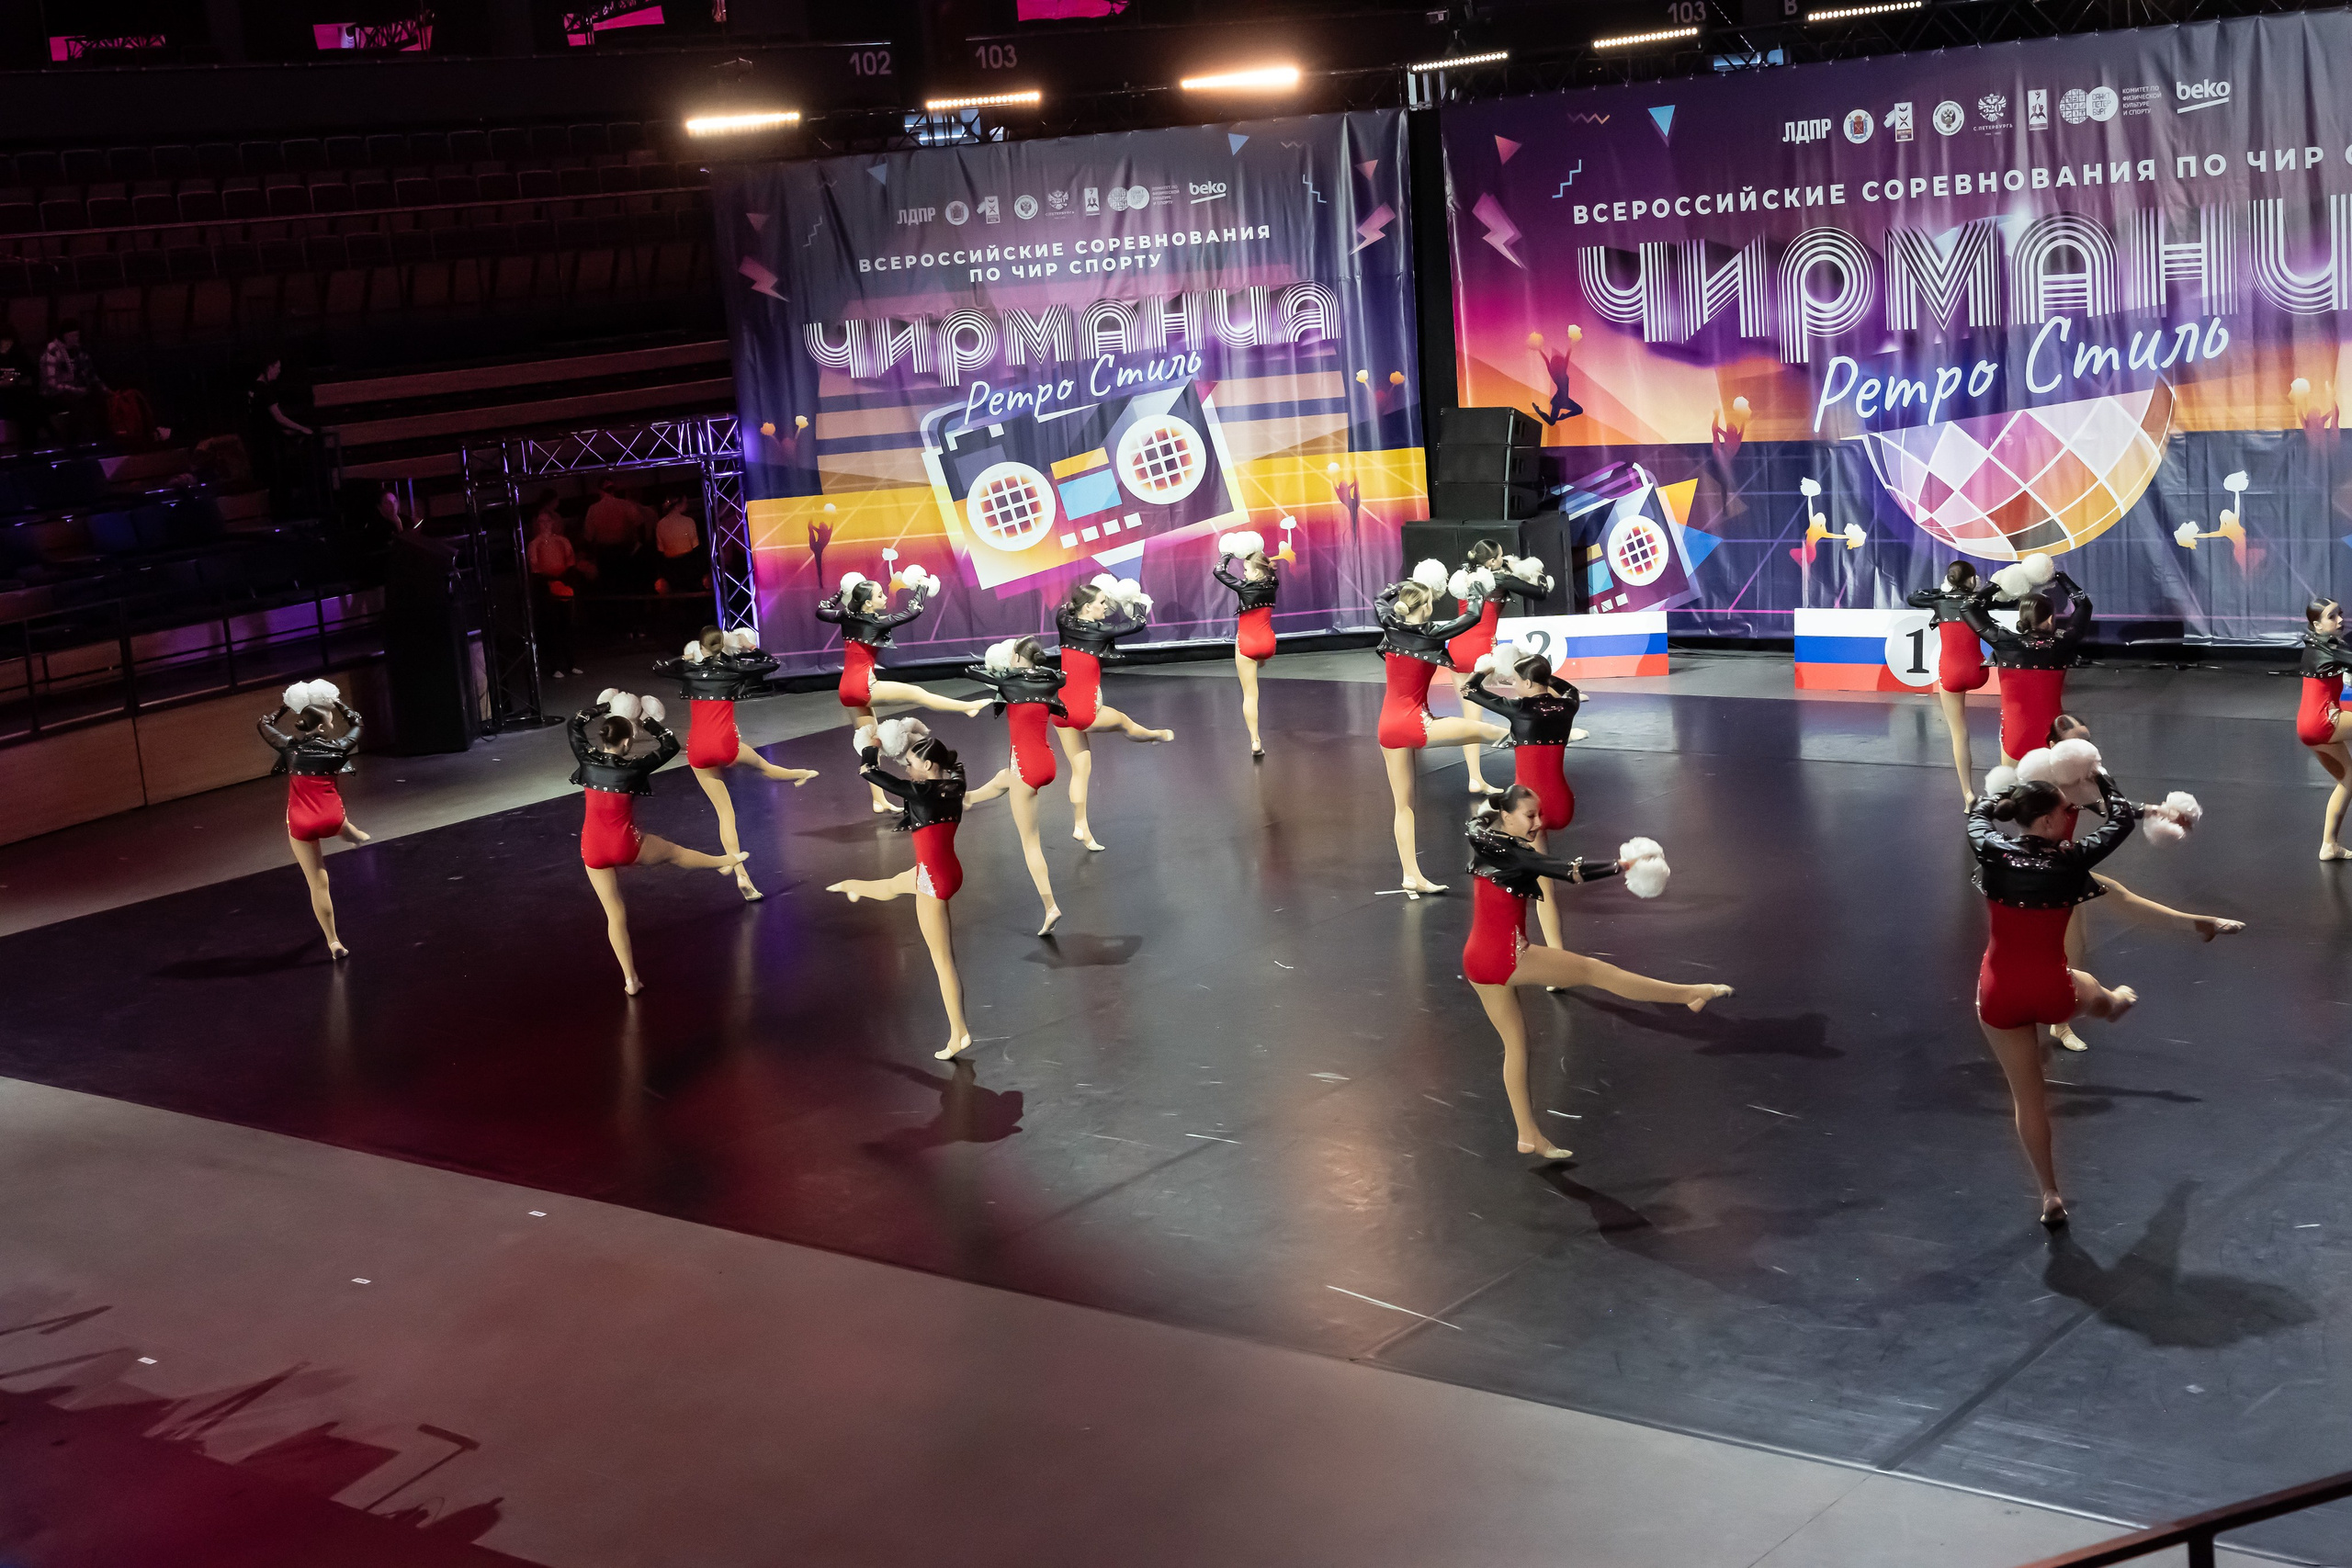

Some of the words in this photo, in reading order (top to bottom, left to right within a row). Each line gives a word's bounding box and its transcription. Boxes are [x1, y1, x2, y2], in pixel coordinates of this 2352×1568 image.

[1667, 1, 1707, 24] 103
[849, 51, 891, 75] 102
[975, 44, 1017, 69] 103
[2176, 79, 2231, 100] beko
[1782, 118, 1832, 144] ЛДПР
[1189, 180, 1227, 196] beko
[1574, 181, 1847, 225] ВСЕРОССИЙСКИЕ
[1862, 158, 2156, 201] СОРЕВНОВАНИЯ
[2177, 153, 2227, 178] ПО
[2247, 146, 2324, 173] ЧИР
[897, 207, 936, 226] ЛДПР
[859, 242, 1064, 274] ВСЕРОССИЙСКИЕ
[1075, 224, 1271, 255] СОРЕВНОВАНИЯ
[969, 265, 1002, 283] ПО
[1012, 259, 1057, 279] ЧИР
[1069, 253, 1162, 276] СПОРТУ
[963, 379, 1074, 426] Ретро
[1091, 350, 1203, 398] Стиль
[1814, 355, 1999, 434] Ретро
[2025, 315, 2231, 397] Стиль
[1526, 630, 1553, 666] 2
[1905, 628, 1929, 673] 1
